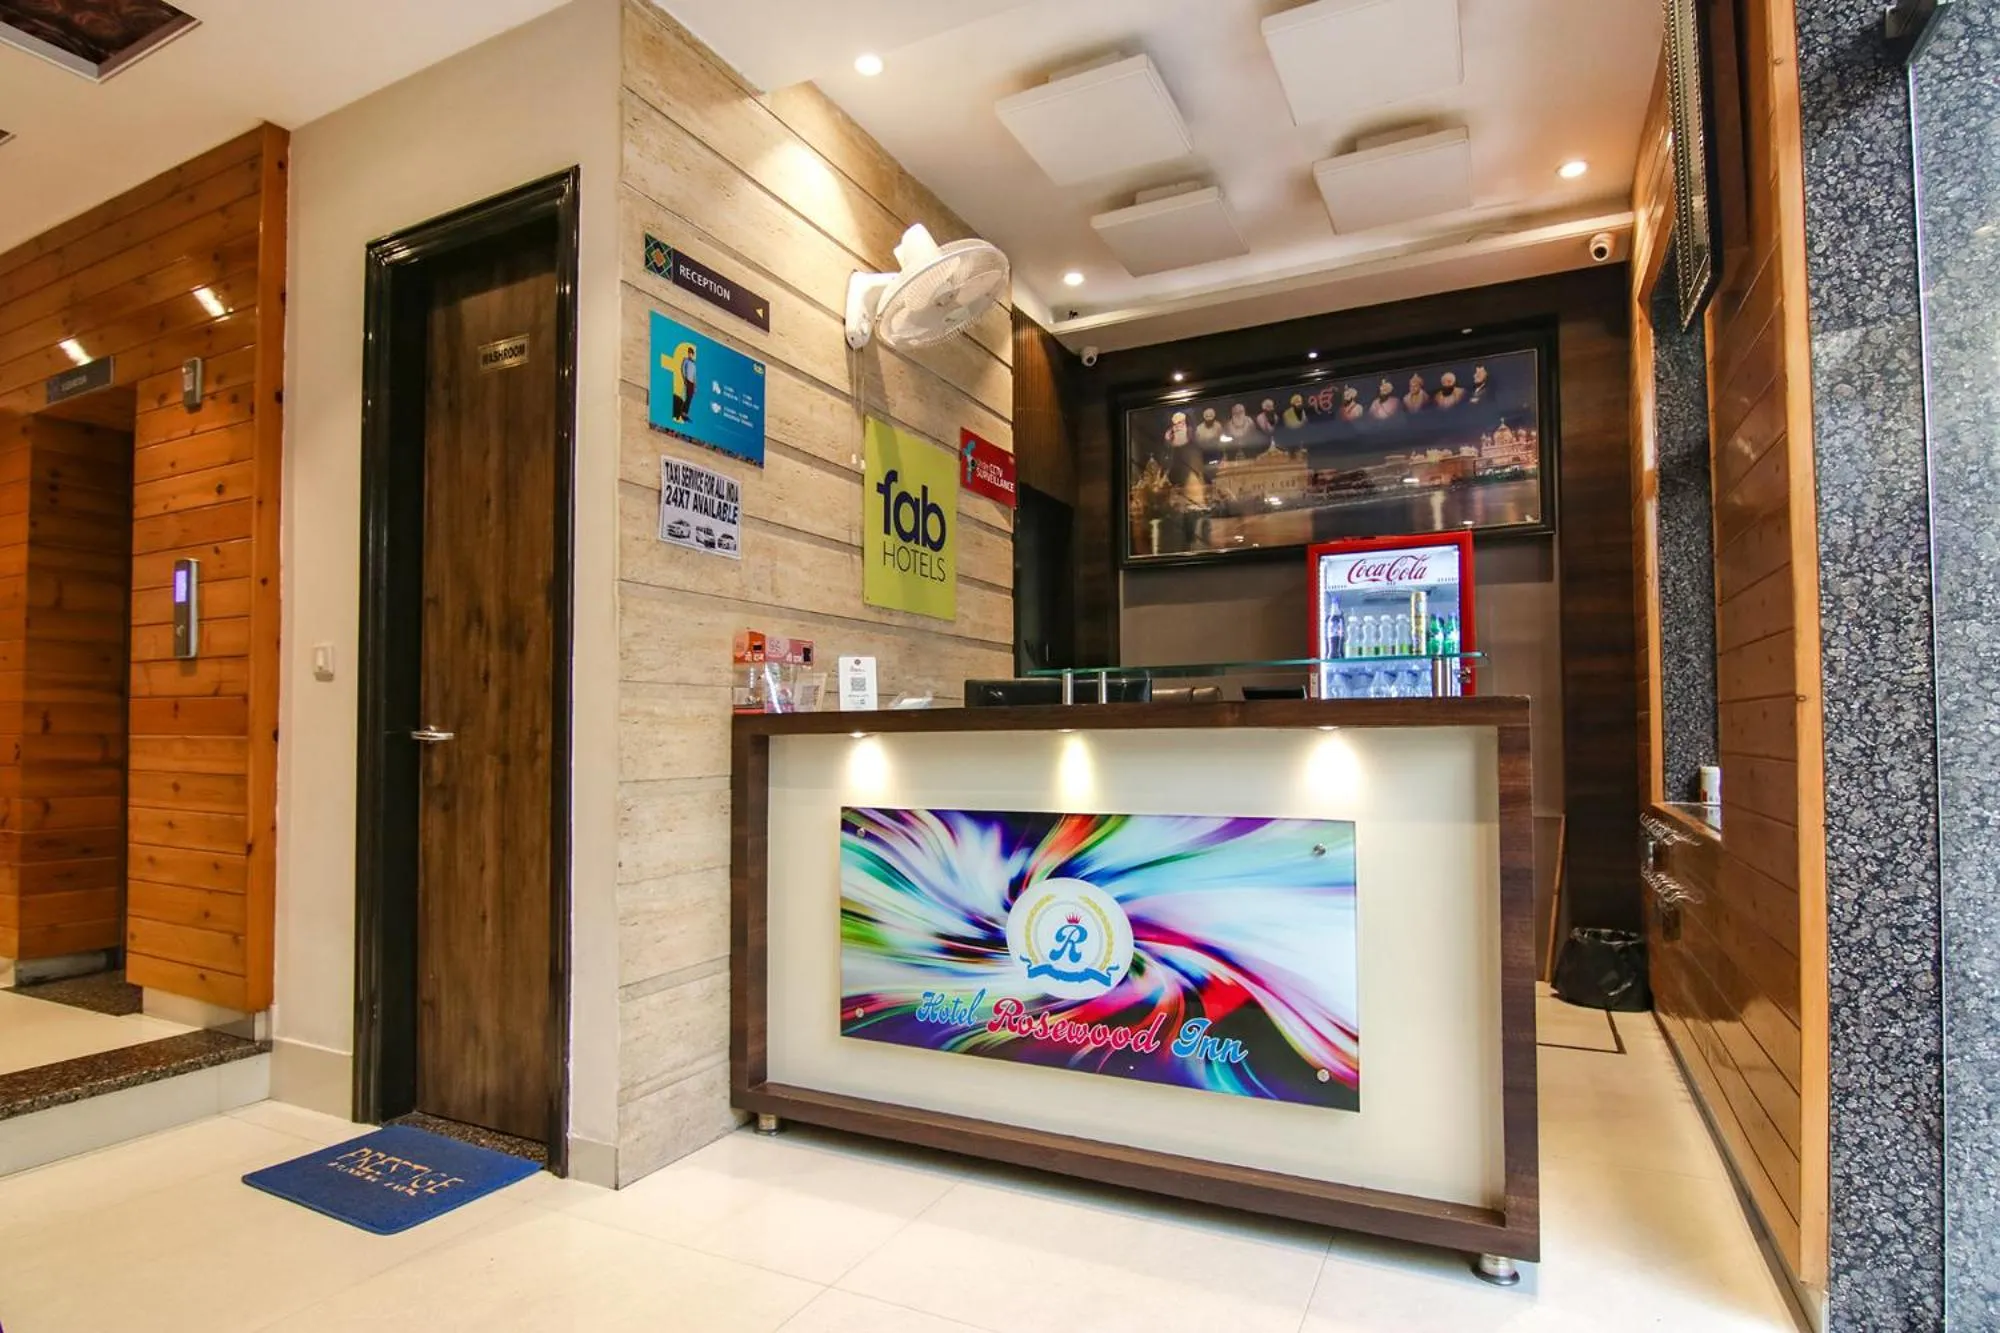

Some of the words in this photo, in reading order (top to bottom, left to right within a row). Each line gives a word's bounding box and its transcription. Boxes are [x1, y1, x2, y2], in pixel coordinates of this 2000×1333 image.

[679, 264, 731, 301] RECEPTION
[482, 343, 526, 366] WASHROOM
[665, 461, 681, 485] TAXI
[682, 465, 704, 493] SERVICE
[704, 473, 716, 497] FOR
[715, 476, 725, 500] ALL
[976, 466, 1015, 493] SURVEILLANCE
[988, 463, 1004, 479] CCTV
[665, 484, 690, 510] 24X7
[692, 493, 739, 525] AVAILABLE
[876, 469, 946, 552] fab
[882, 540, 946, 582] HOTELS
[1048, 924, 1088, 964] R
[915, 987, 987, 1028] Hotel
[986, 997, 1166, 1054] Rosewood
[1171, 1016, 1248, 1064] Inn
